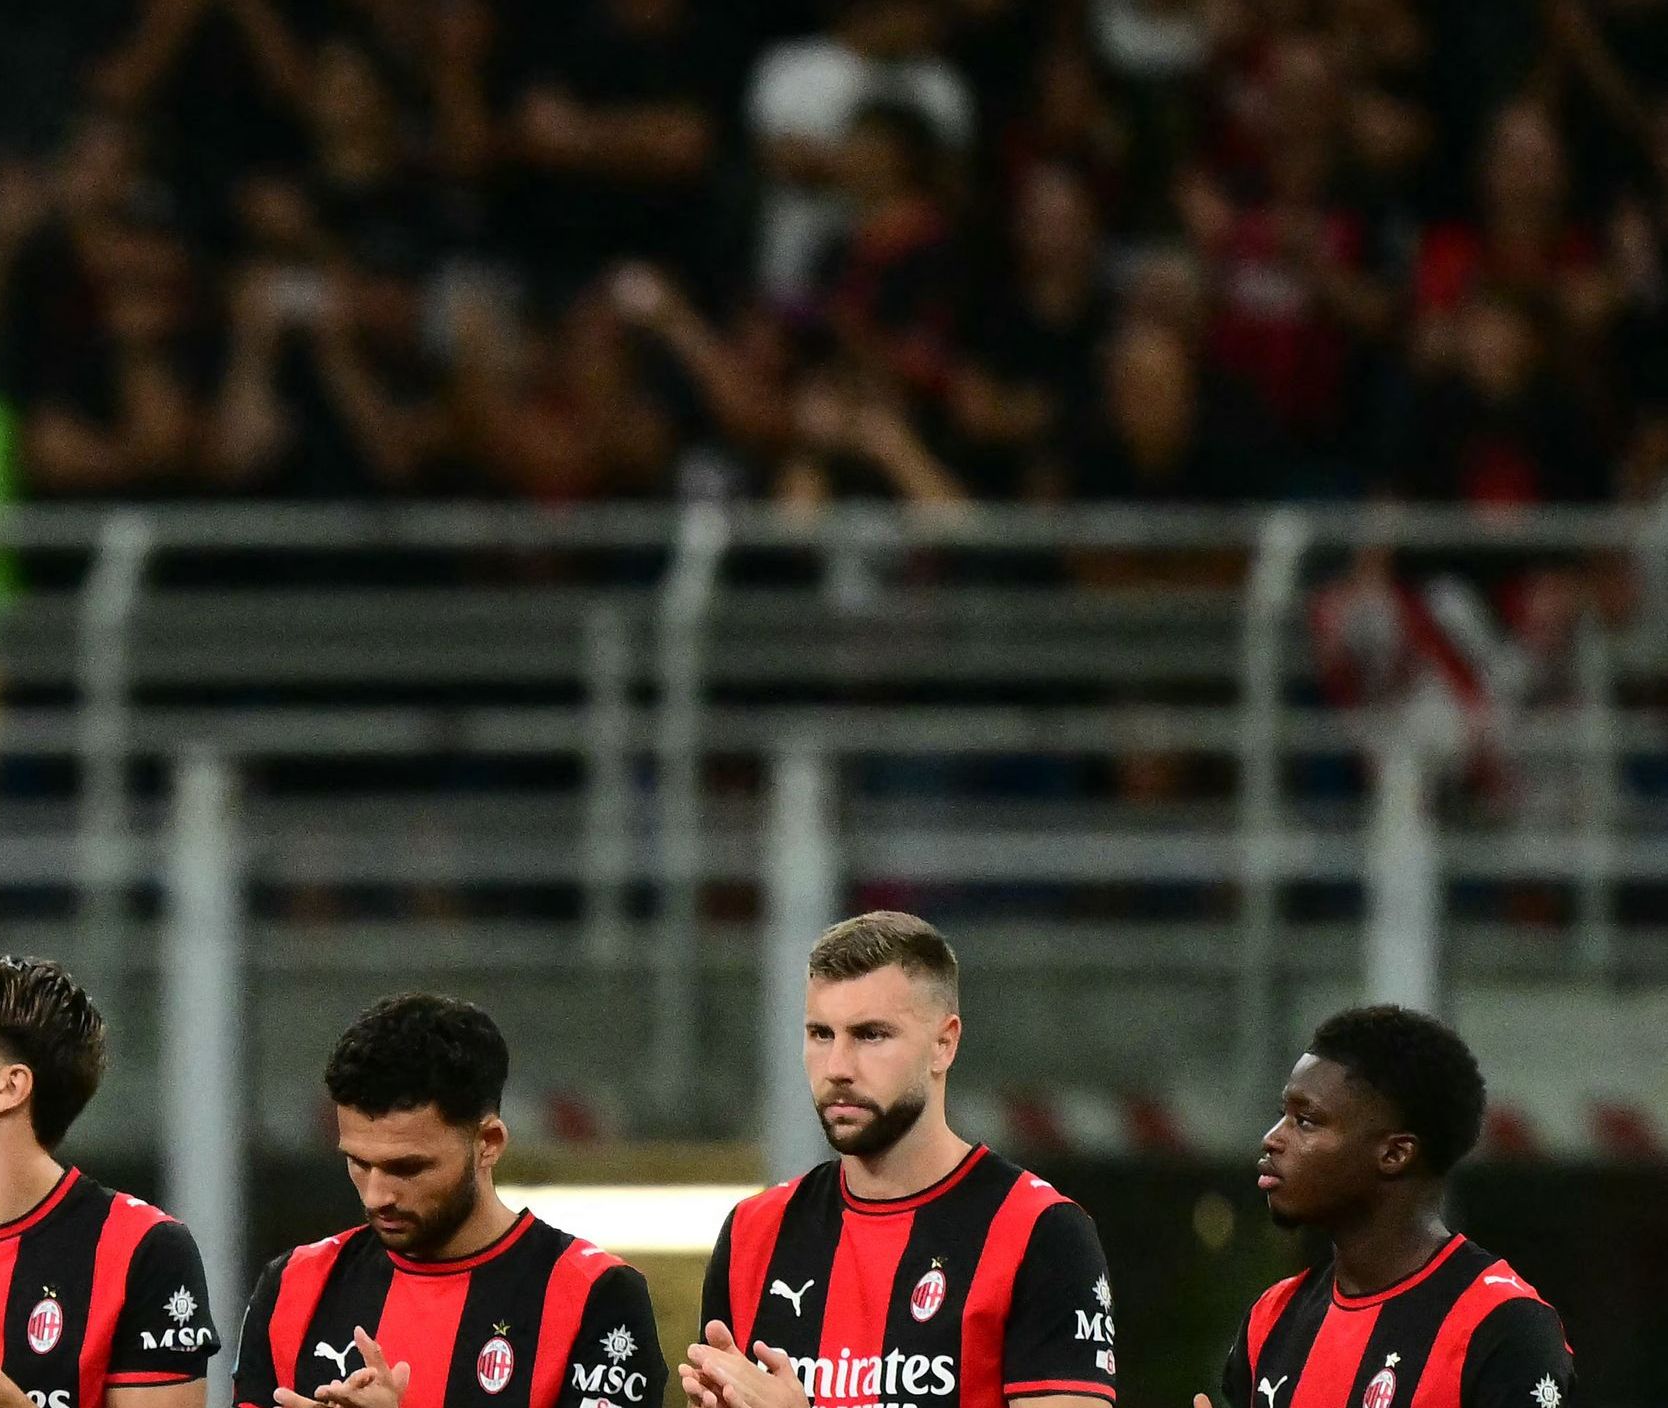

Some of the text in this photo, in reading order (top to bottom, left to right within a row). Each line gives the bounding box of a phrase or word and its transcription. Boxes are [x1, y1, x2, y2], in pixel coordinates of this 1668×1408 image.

[1074, 1310, 1115, 1345] MS
[572, 1362, 648, 1403] MSC
[757, 1346, 957, 1399] mirates
